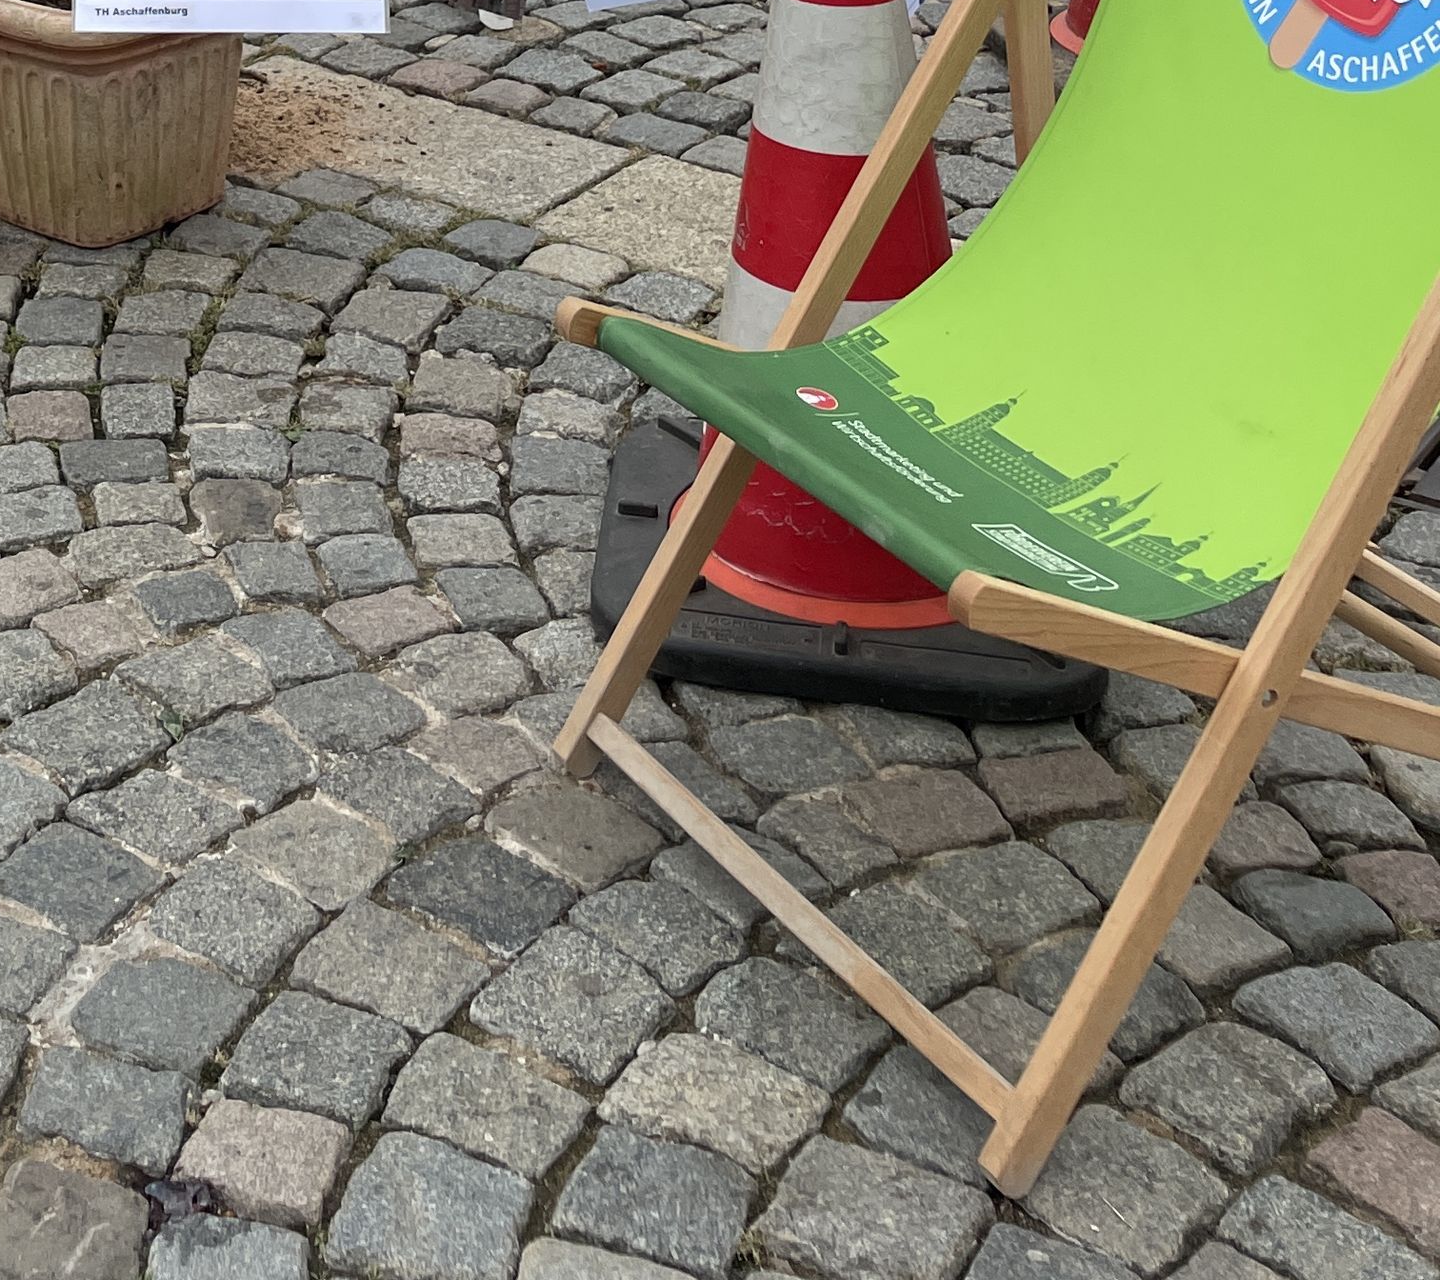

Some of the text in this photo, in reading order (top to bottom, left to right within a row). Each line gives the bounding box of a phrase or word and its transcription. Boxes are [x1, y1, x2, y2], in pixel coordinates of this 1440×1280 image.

[95, 5, 188, 18] TH Aschaffenburg
[1307, 19, 1440, 83] ASCHAFFE
